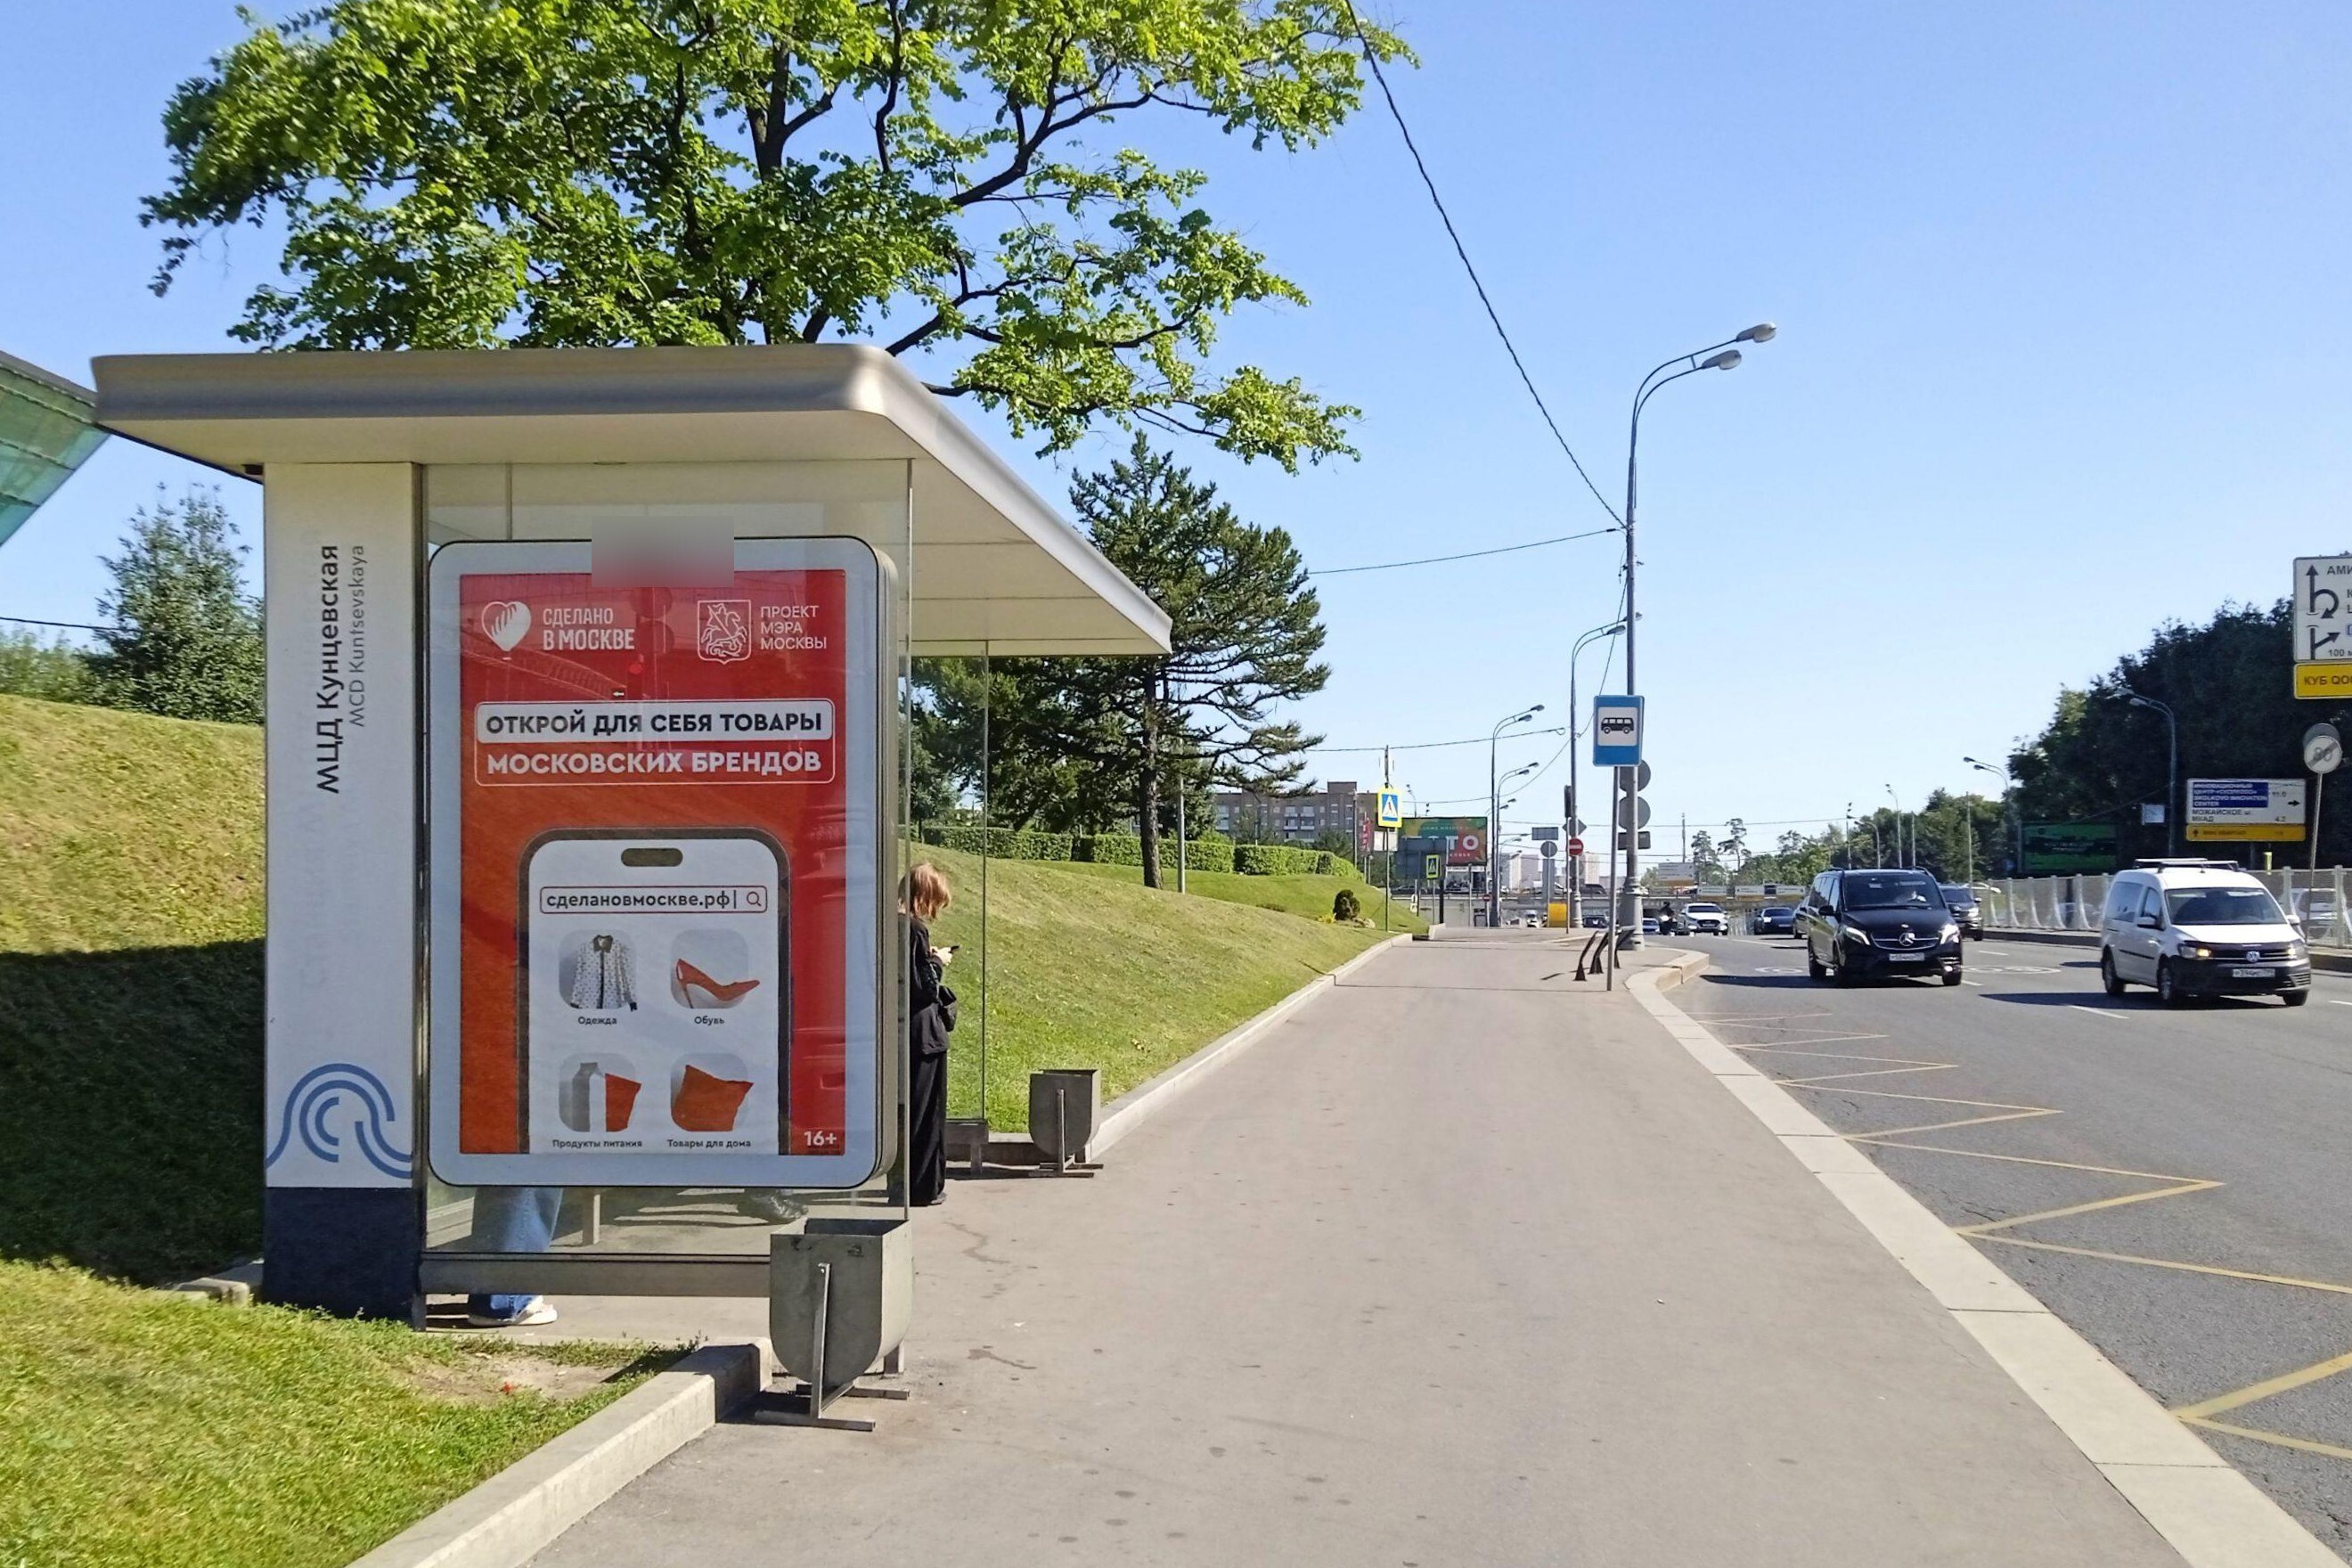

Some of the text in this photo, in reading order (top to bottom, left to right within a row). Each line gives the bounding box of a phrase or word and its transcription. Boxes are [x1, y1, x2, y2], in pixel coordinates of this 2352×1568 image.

[543, 608, 613, 628] СДЕЛАНО
[760, 605, 819, 618] ПРОЕКТ
[760, 621, 803, 634] МЭРА
[347, 545, 368, 727] MCD Kuntsevskaya
[543, 628, 635, 650] В МОСКВЕ
[760, 636, 827, 650] МОСКВЫ
[316, 545, 345, 794] МЦД Кунцевская
[2332, 674, 2352, 685] QO
[486, 708, 821, 737] ОТКРОЙ ДЛЯ СЕБЯ ТОВАРЫ
[487, 751, 821, 776] МОСКОВСКИХ БРЕНДОВ
[546, 890, 731, 909] сделановмоскве.рф
[577, 1016, 617, 1025] Одежда
[693, 1016, 725, 1025] Обувь
[551, 1139, 601, 1148] Продукты
[666, 1139, 704, 1148] Товары
[804, 1130, 837, 1147] 16+
